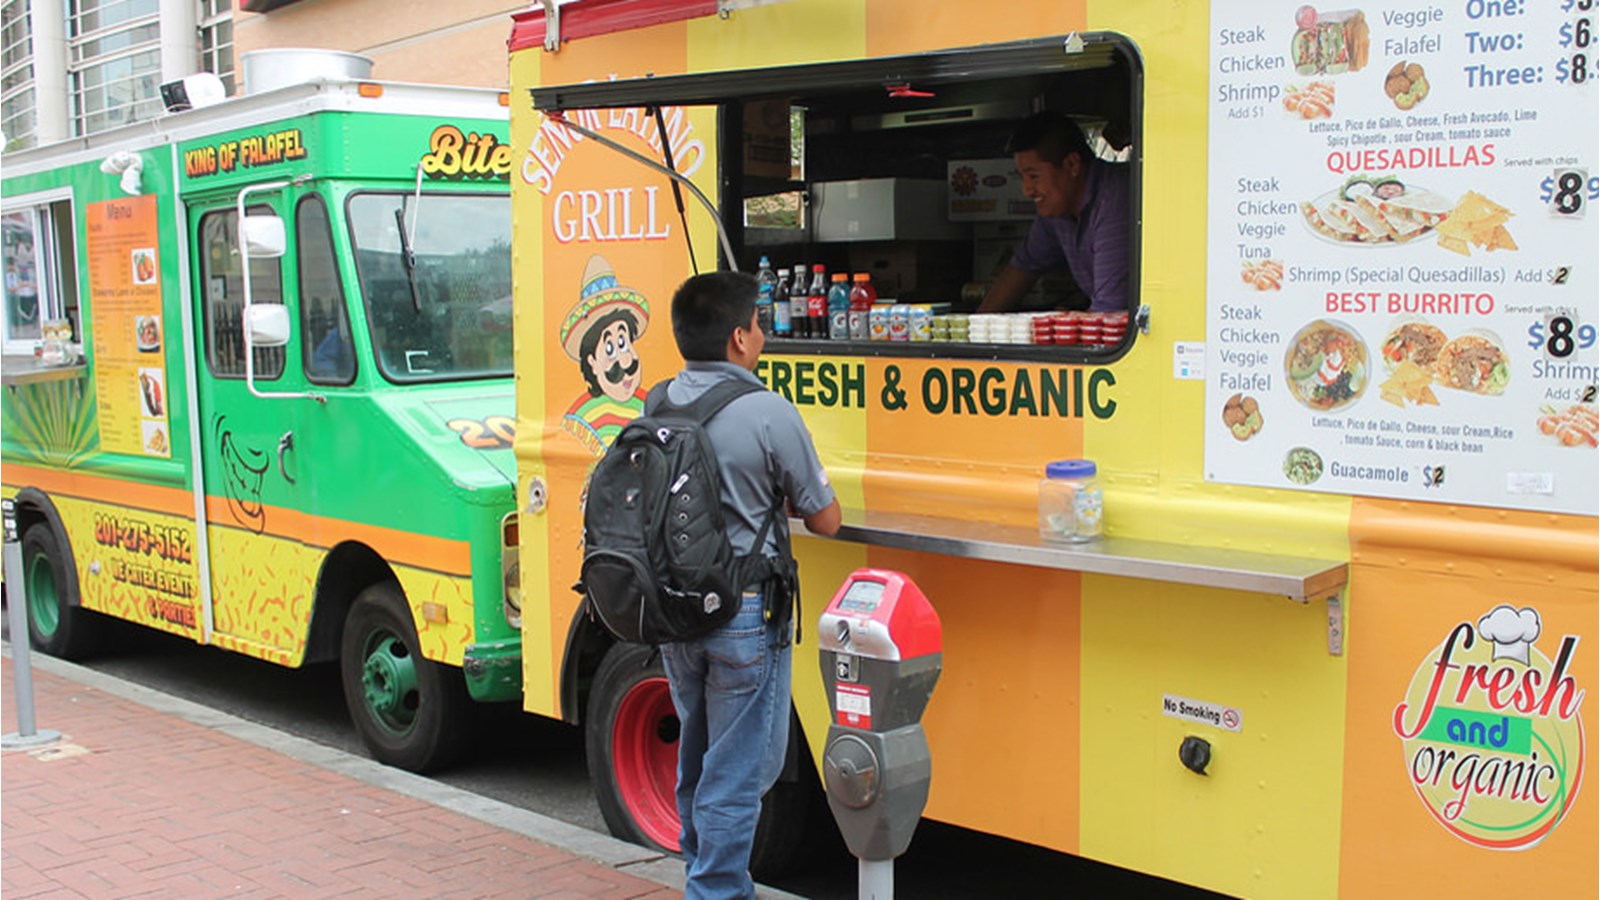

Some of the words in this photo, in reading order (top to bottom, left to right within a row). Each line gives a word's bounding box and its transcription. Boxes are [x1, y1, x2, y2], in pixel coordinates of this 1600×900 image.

[1383, 6, 1444, 29] Veggie
[1466, 0, 1524, 19] One:
[1220, 25, 1265, 45] Steak
[1384, 34, 1441, 56] Falafel
[1465, 31, 1523, 54] Two:
[1220, 54, 1285, 73] Chicken
[1464, 64, 1543, 88] Three:
[1556, 53, 1599, 84] $8.
[1218, 83, 1280, 102] Shrimp
[1228, 107, 1249, 119] Add
[1252, 106, 1264, 118] $1
[1309, 122, 1343, 133] Lettuce,
[1345, 119, 1364, 131] Pico
[1366, 119, 1377, 129] de
[1379, 117, 1403, 129] Gallo,
[1406, 115, 1440, 127] Cheese,
[1443, 113, 1468, 125] Fresh
[1470, 111, 1511, 123] Avocado,
[1514, 109, 1537, 121] Lime
[1327, 134, 1349, 147] Spicy
[1394, 132, 1413, 143] sour
[1448, 128, 1481, 140] tomato
[1483, 127, 1511, 138] sauce
[185, 144, 218, 178] KING
[218, 141, 240, 173] OF
[240, 128, 307, 169] FALAFEL
[1326, 144, 1496, 174] QUESADILLAS
[1504, 158, 1533, 168] Served
[1535, 157, 1554, 166] with
[1555, 156, 1578, 165] chips
[1237, 176, 1280, 193] Steak
[552, 185, 671, 243] GRILL
[1237, 200, 1298, 216] Chicken
[1237, 222, 1287, 239] Veggie
[1237, 244, 1272, 258] Tuna
[1289, 266, 1341, 285] Shrimp
[1345, 266, 1404, 285] (Special
[1407, 266, 1506, 285] Quesadillas)
[1514, 269, 1542, 283] Add
[1220, 304, 1262, 320] Steak
[1326, 292, 1381, 313] BEST
[1387, 292, 1495, 315] BURRITO
[1504, 303, 1533, 313] Served
[1535, 305, 1553, 314] with
[1219, 327, 1280, 344] Chicken
[1219, 349, 1269, 367] Veggie
[756, 360, 866, 409] FRESH
[881, 364, 908, 411] &
[921, 367, 1118, 420] ORGANIC
[1219, 372, 1272, 391] Falafel
[1544, 387, 1570, 400] Add
[1312, 417, 1344, 429] Lettuce,
[1347, 418, 1365, 429] Pico
[1367, 420, 1377, 430] de
[1380, 420, 1404, 433] Gallo,
[1406, 421, 1439, 434] Cheese,
[1441, 425, 1460, 435] sour
[1345, 434, 1373, 445] tomato
[1376, 435, 1403, 448] Sauce,
[1406, 439, 1425, 449] corn
[1427, 438, 1434, 449] &
[1436, 440, 1459, 451] black
[1462, 441, 1484, 453] bean
[1331, 461, 1409, 483] Guacamole
[94, 511, 191, 565] 201-275-5152
[157, 569, 192, 599] EVENT
[157, 597, 197, 630] PARTIE
[1394, 622, 1584, 739] fresh
[1164, 699, 1178, 712] No
[1179, 701, 1221, 725] Smoking
[1446, 716, 1509, 748] and
[1413, 746, 1555, 821] organic
